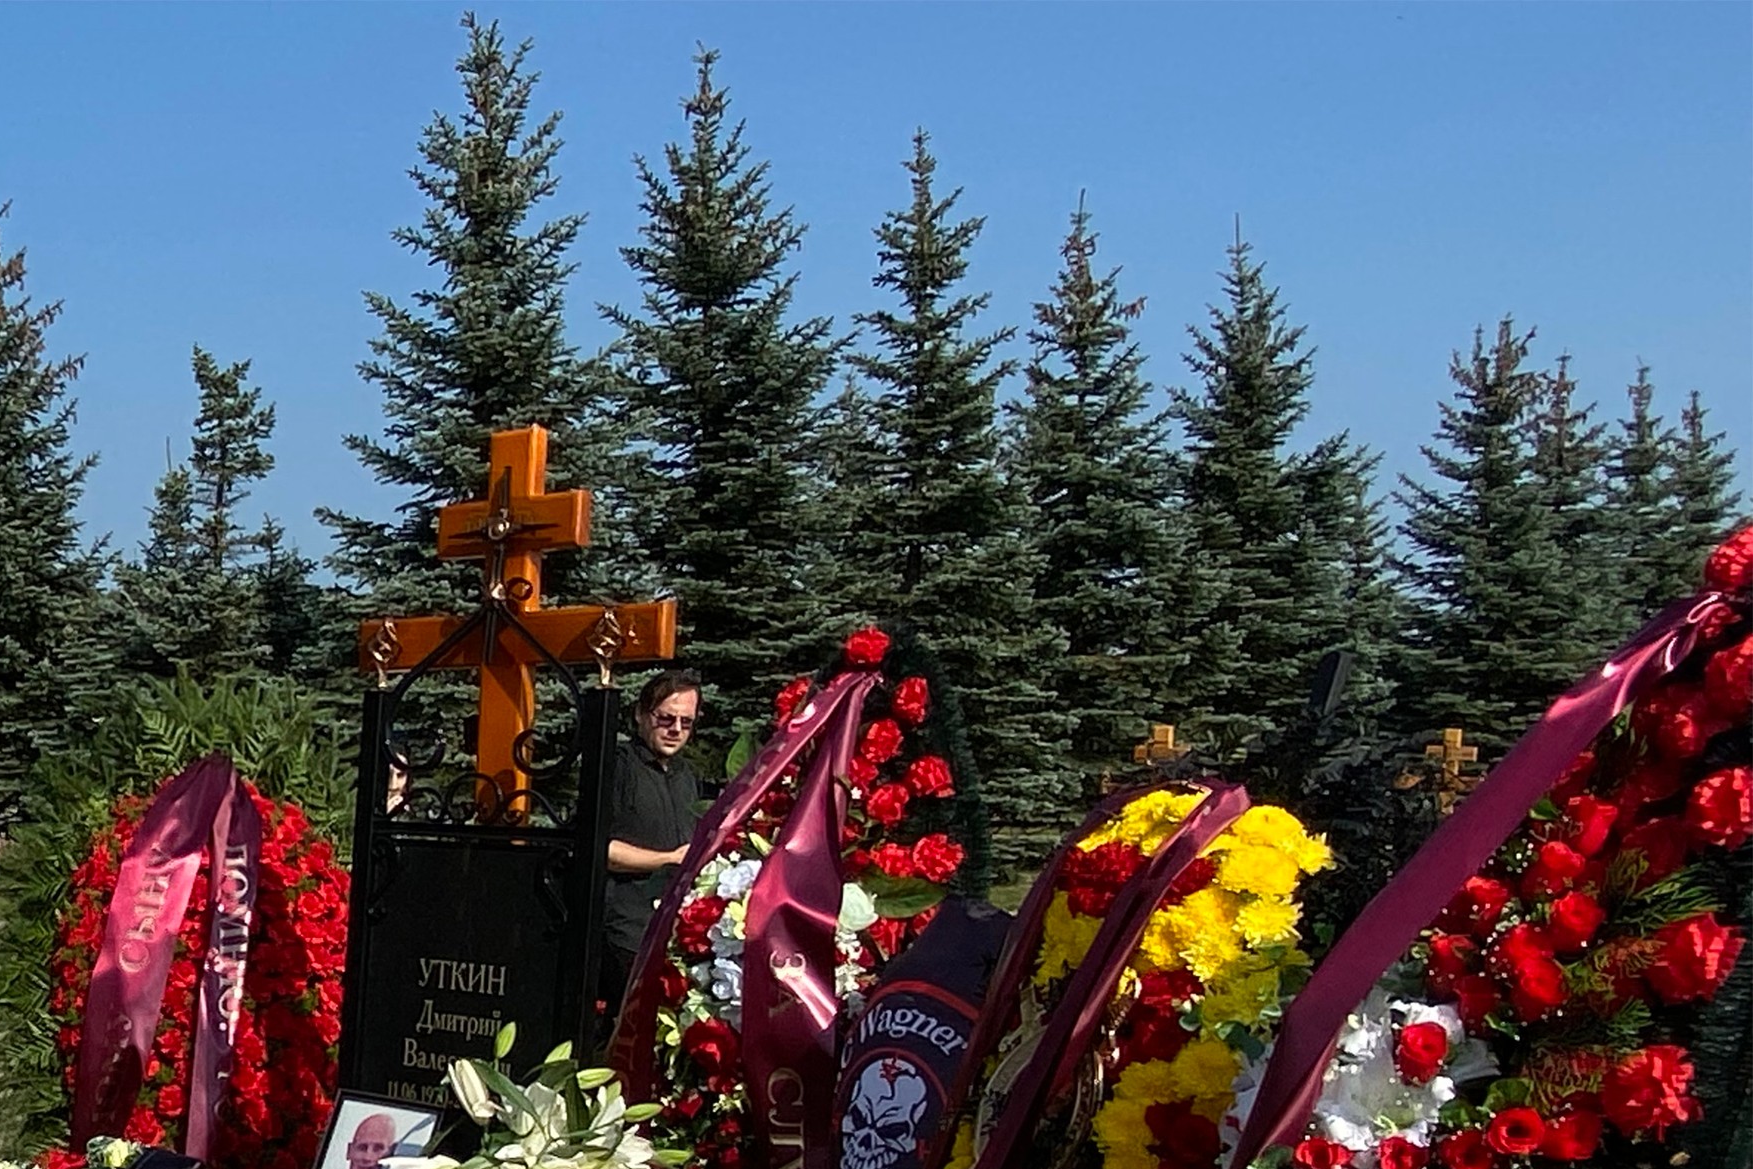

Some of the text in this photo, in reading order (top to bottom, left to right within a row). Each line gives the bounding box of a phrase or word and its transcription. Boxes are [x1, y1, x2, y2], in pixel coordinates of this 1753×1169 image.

[418, 958, 506, 996] УТКИН
[416, 1000, 502, 1041] Дмитрий
[859, 1002, 968, 1056] Wagner
